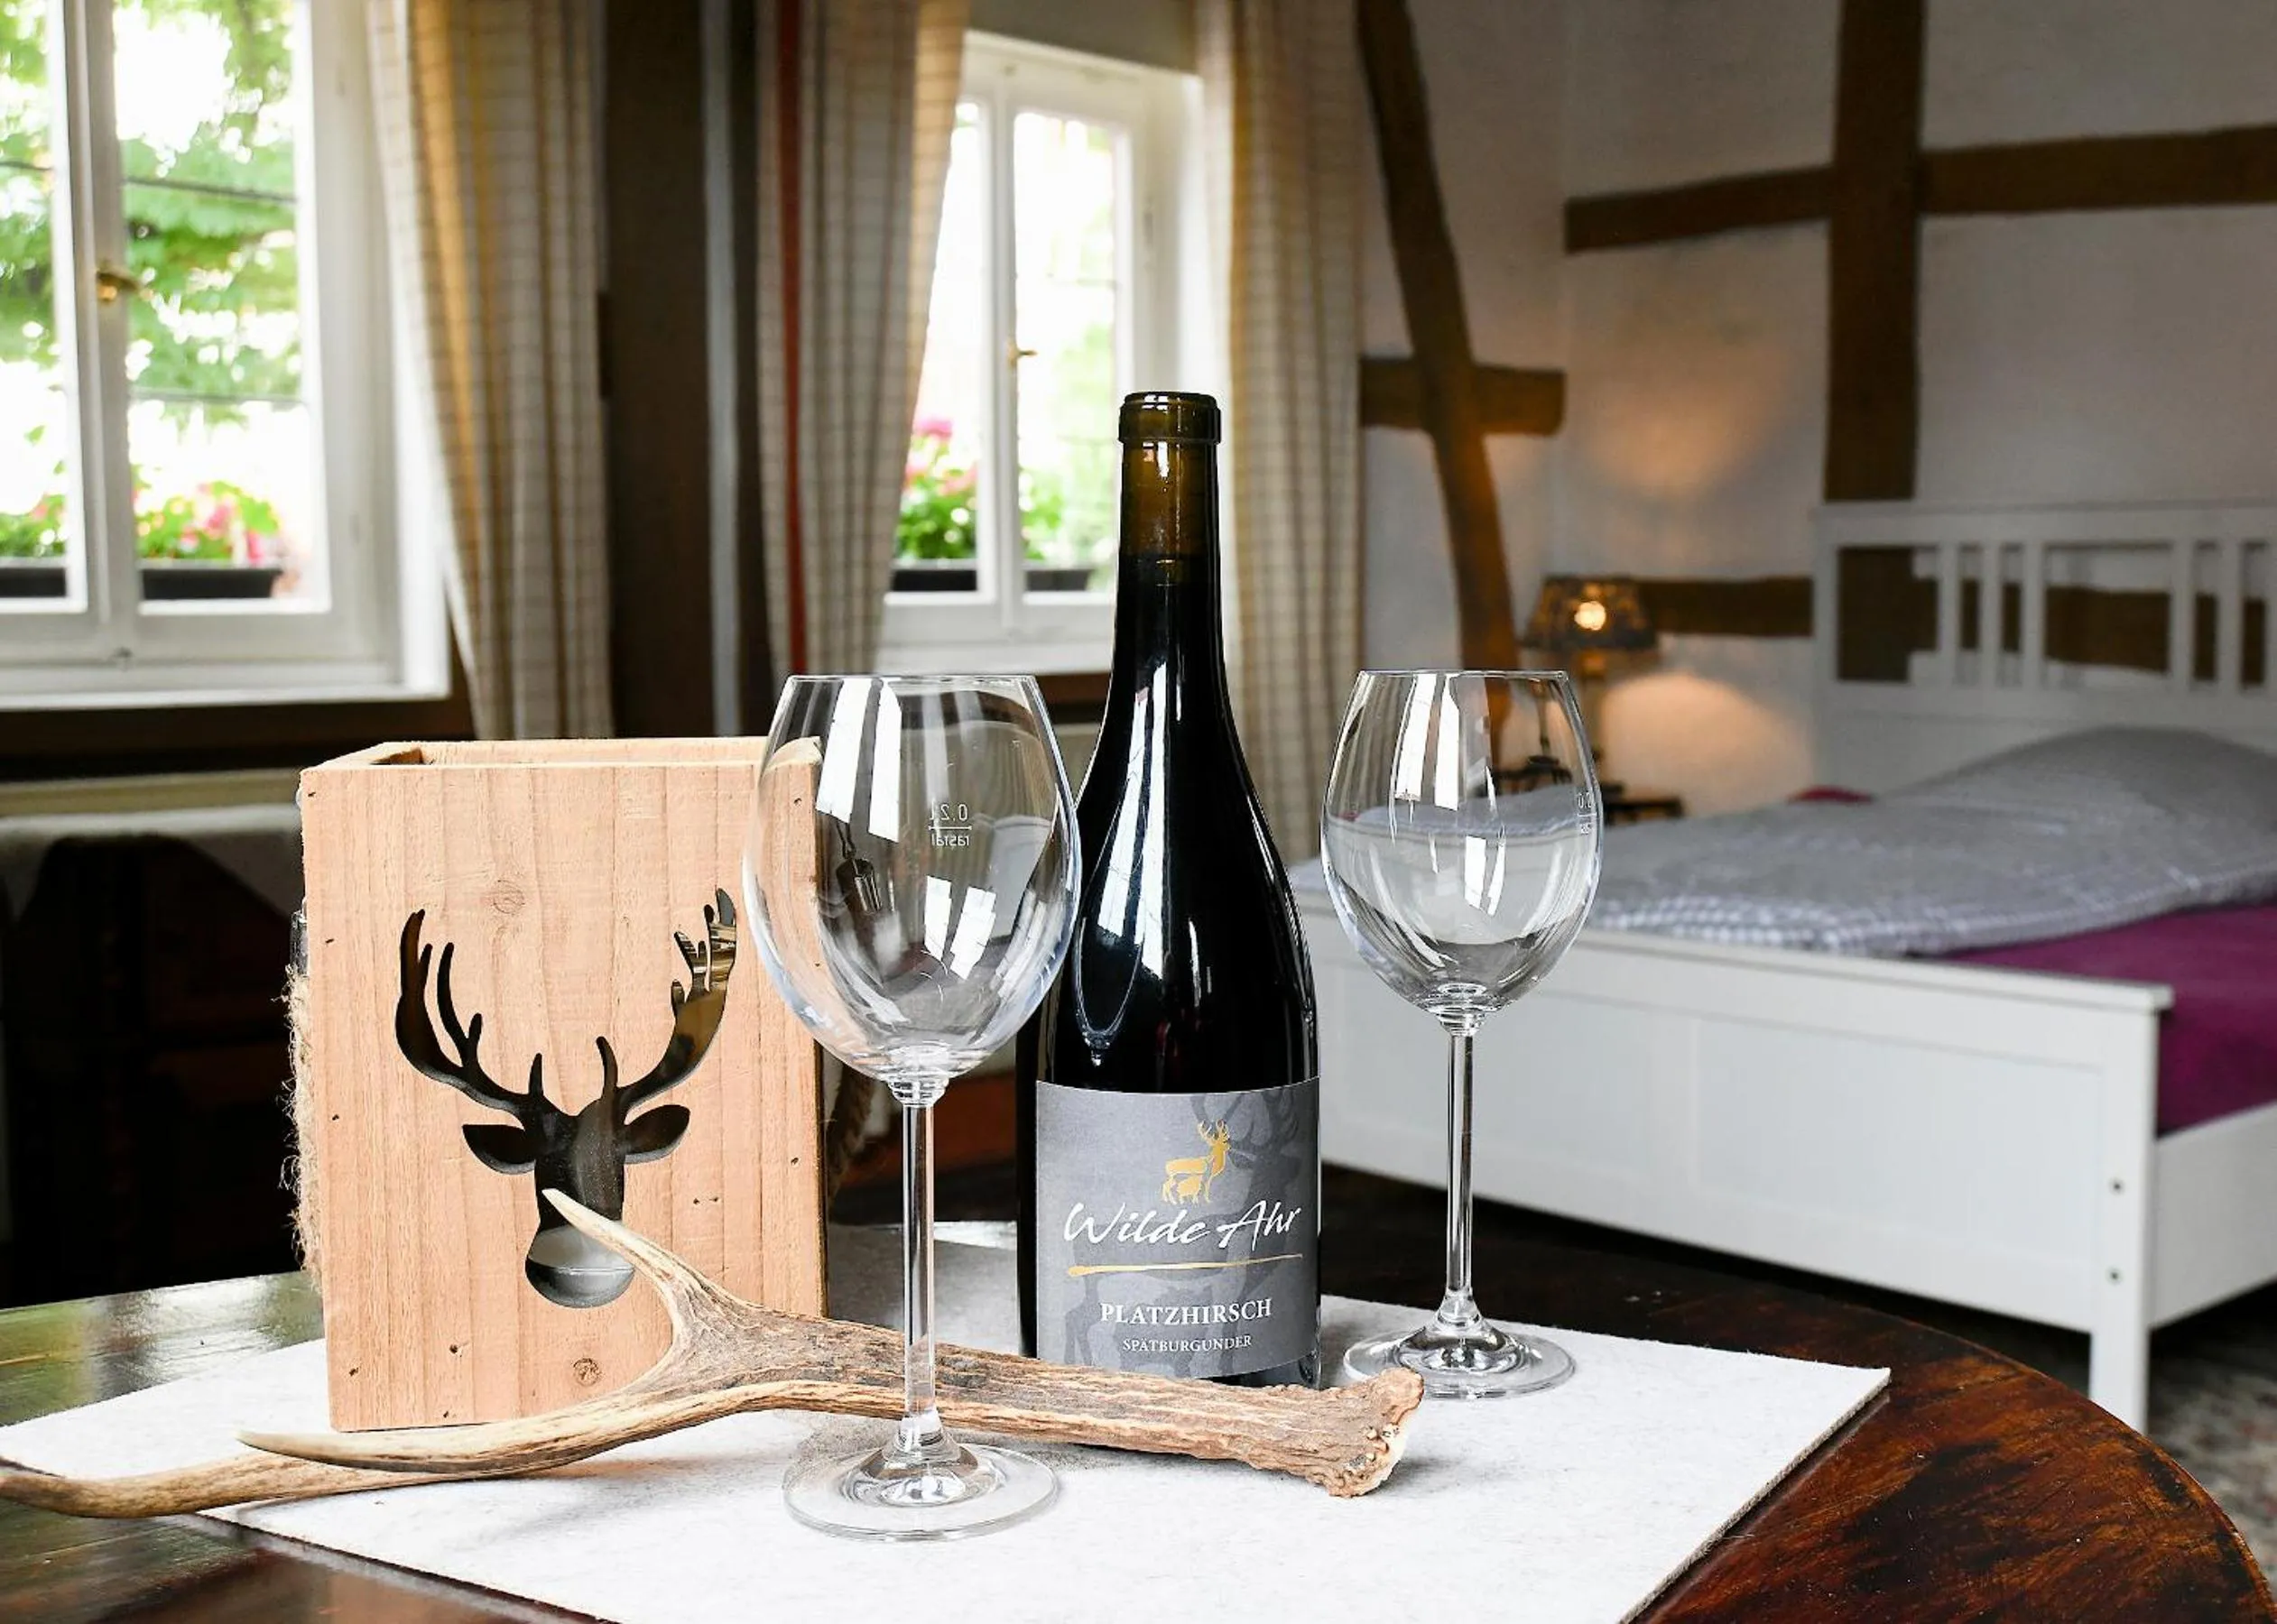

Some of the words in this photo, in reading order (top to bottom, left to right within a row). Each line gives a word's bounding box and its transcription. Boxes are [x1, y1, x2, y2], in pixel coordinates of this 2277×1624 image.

[1063, 1202, 1210, 1245] Wilde
[1217, 1199, 1302, 1251] Ahr
[1099, 1297, 1273, 1326] PLATZHIRSCH
[1122, 1334, 1253, 1352] SPÄTBURGUNDER
